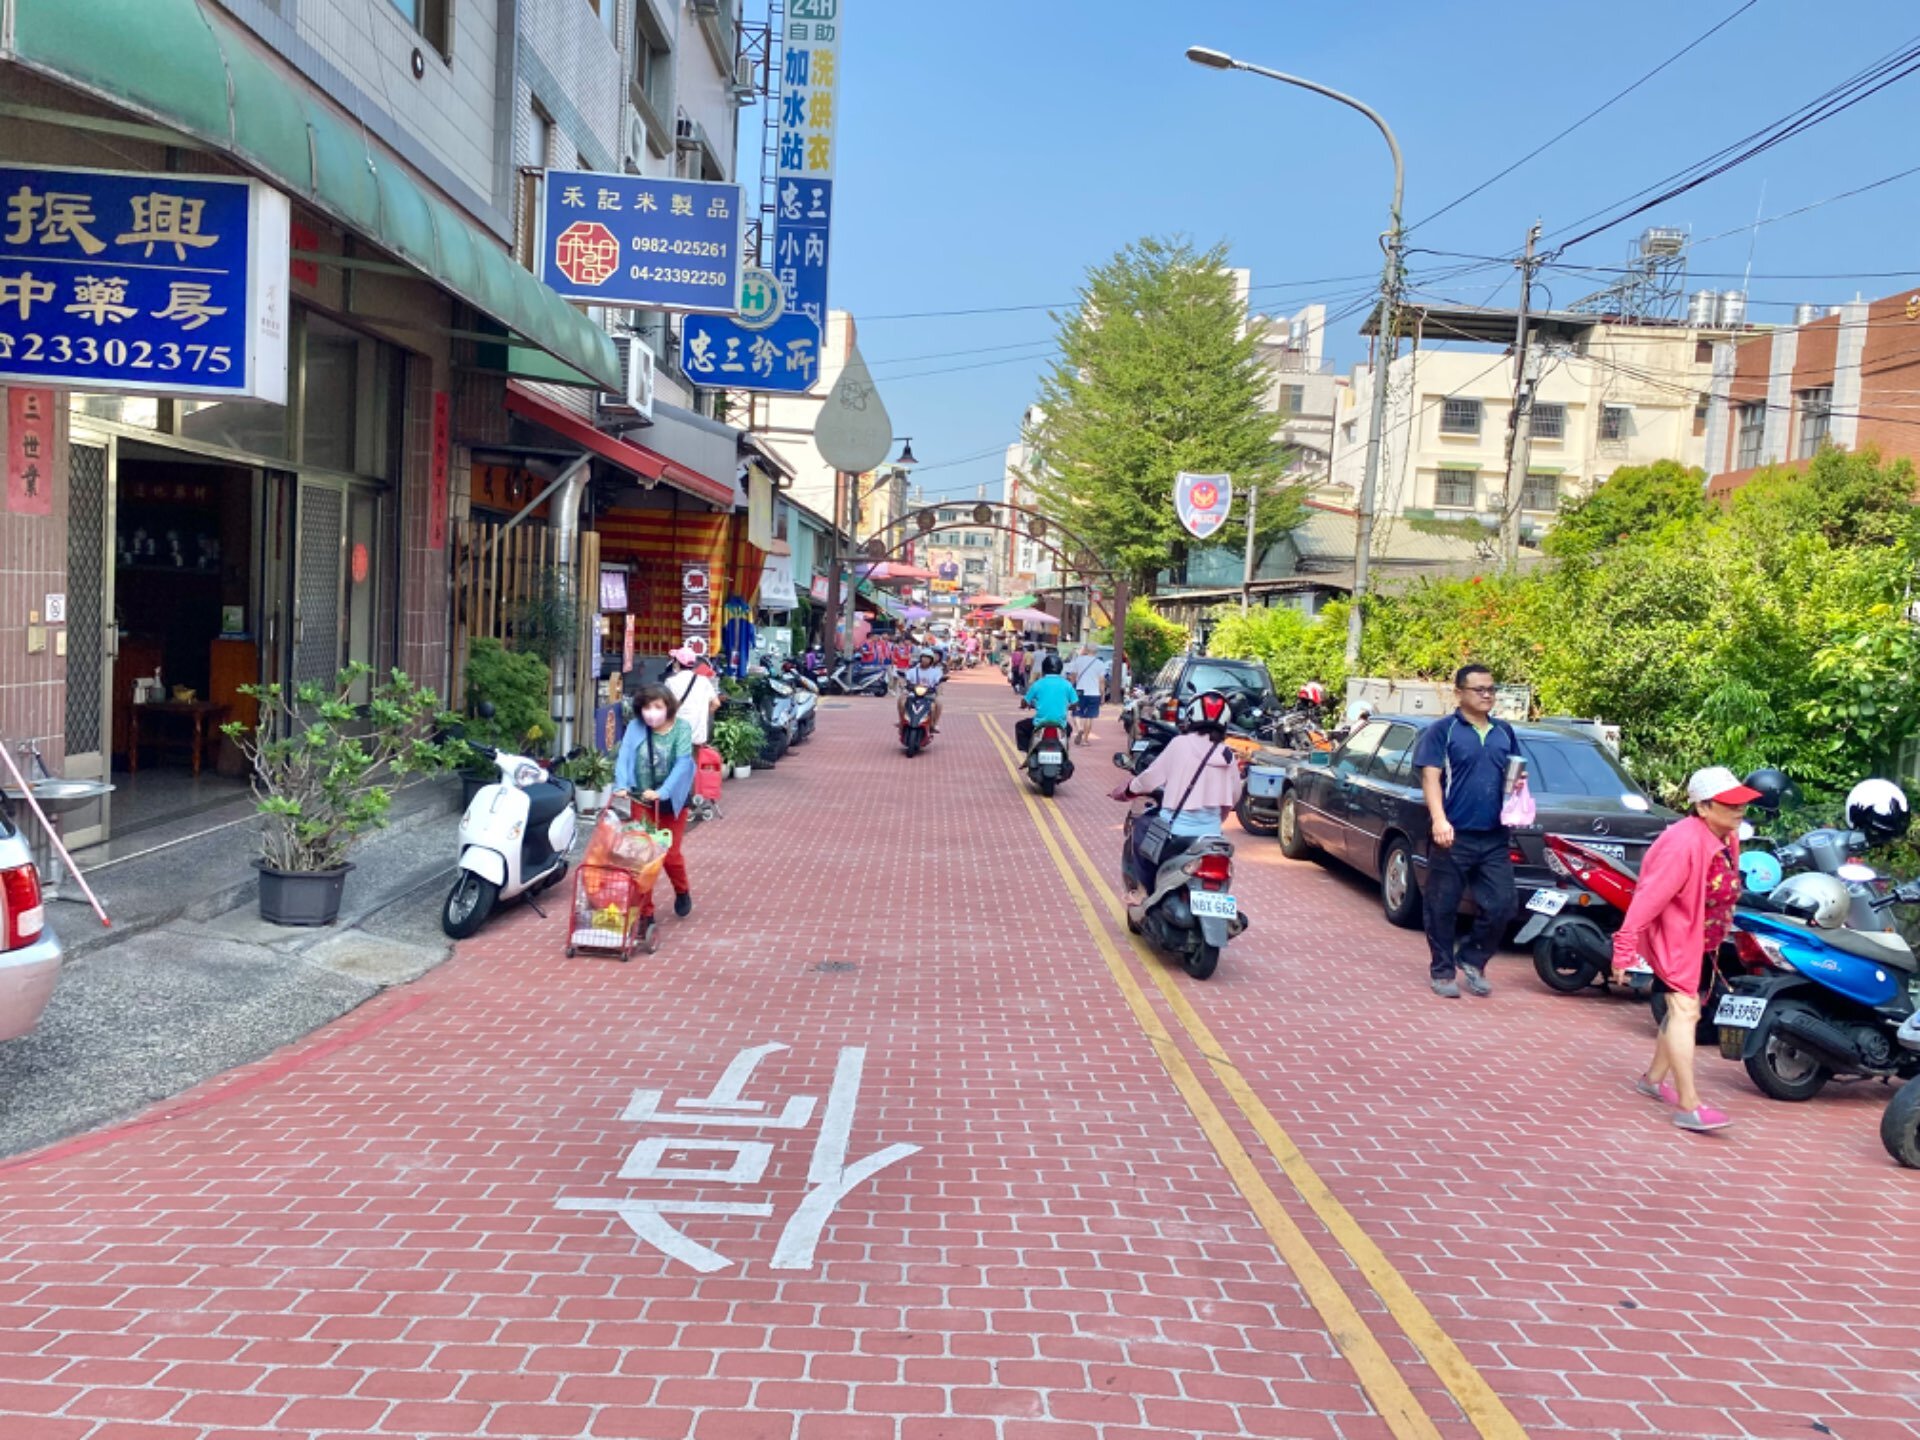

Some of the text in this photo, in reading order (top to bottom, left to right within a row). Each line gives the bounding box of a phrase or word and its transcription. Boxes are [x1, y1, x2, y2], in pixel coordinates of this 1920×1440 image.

[792, 0, 833, 16] 24H
[790, 24, 835, 42] 自助
[780, 47, 809, 170] 加水站
[807, 48, 834, 171] 洗烘衣
[561, 186, 731, 219] 禾記米製品
[779, 181, 828, 220] 忠三
[5, 186, 219, 261] 振興
[631, 236, 727, 258] 0982-025261
[629, 265, 727, 287] 04-23392250
[0, 271, 228, 331] 中藥房
[21, 333, 232, 373] 23302375
[687, 328, 816, 380] 忠三診所
